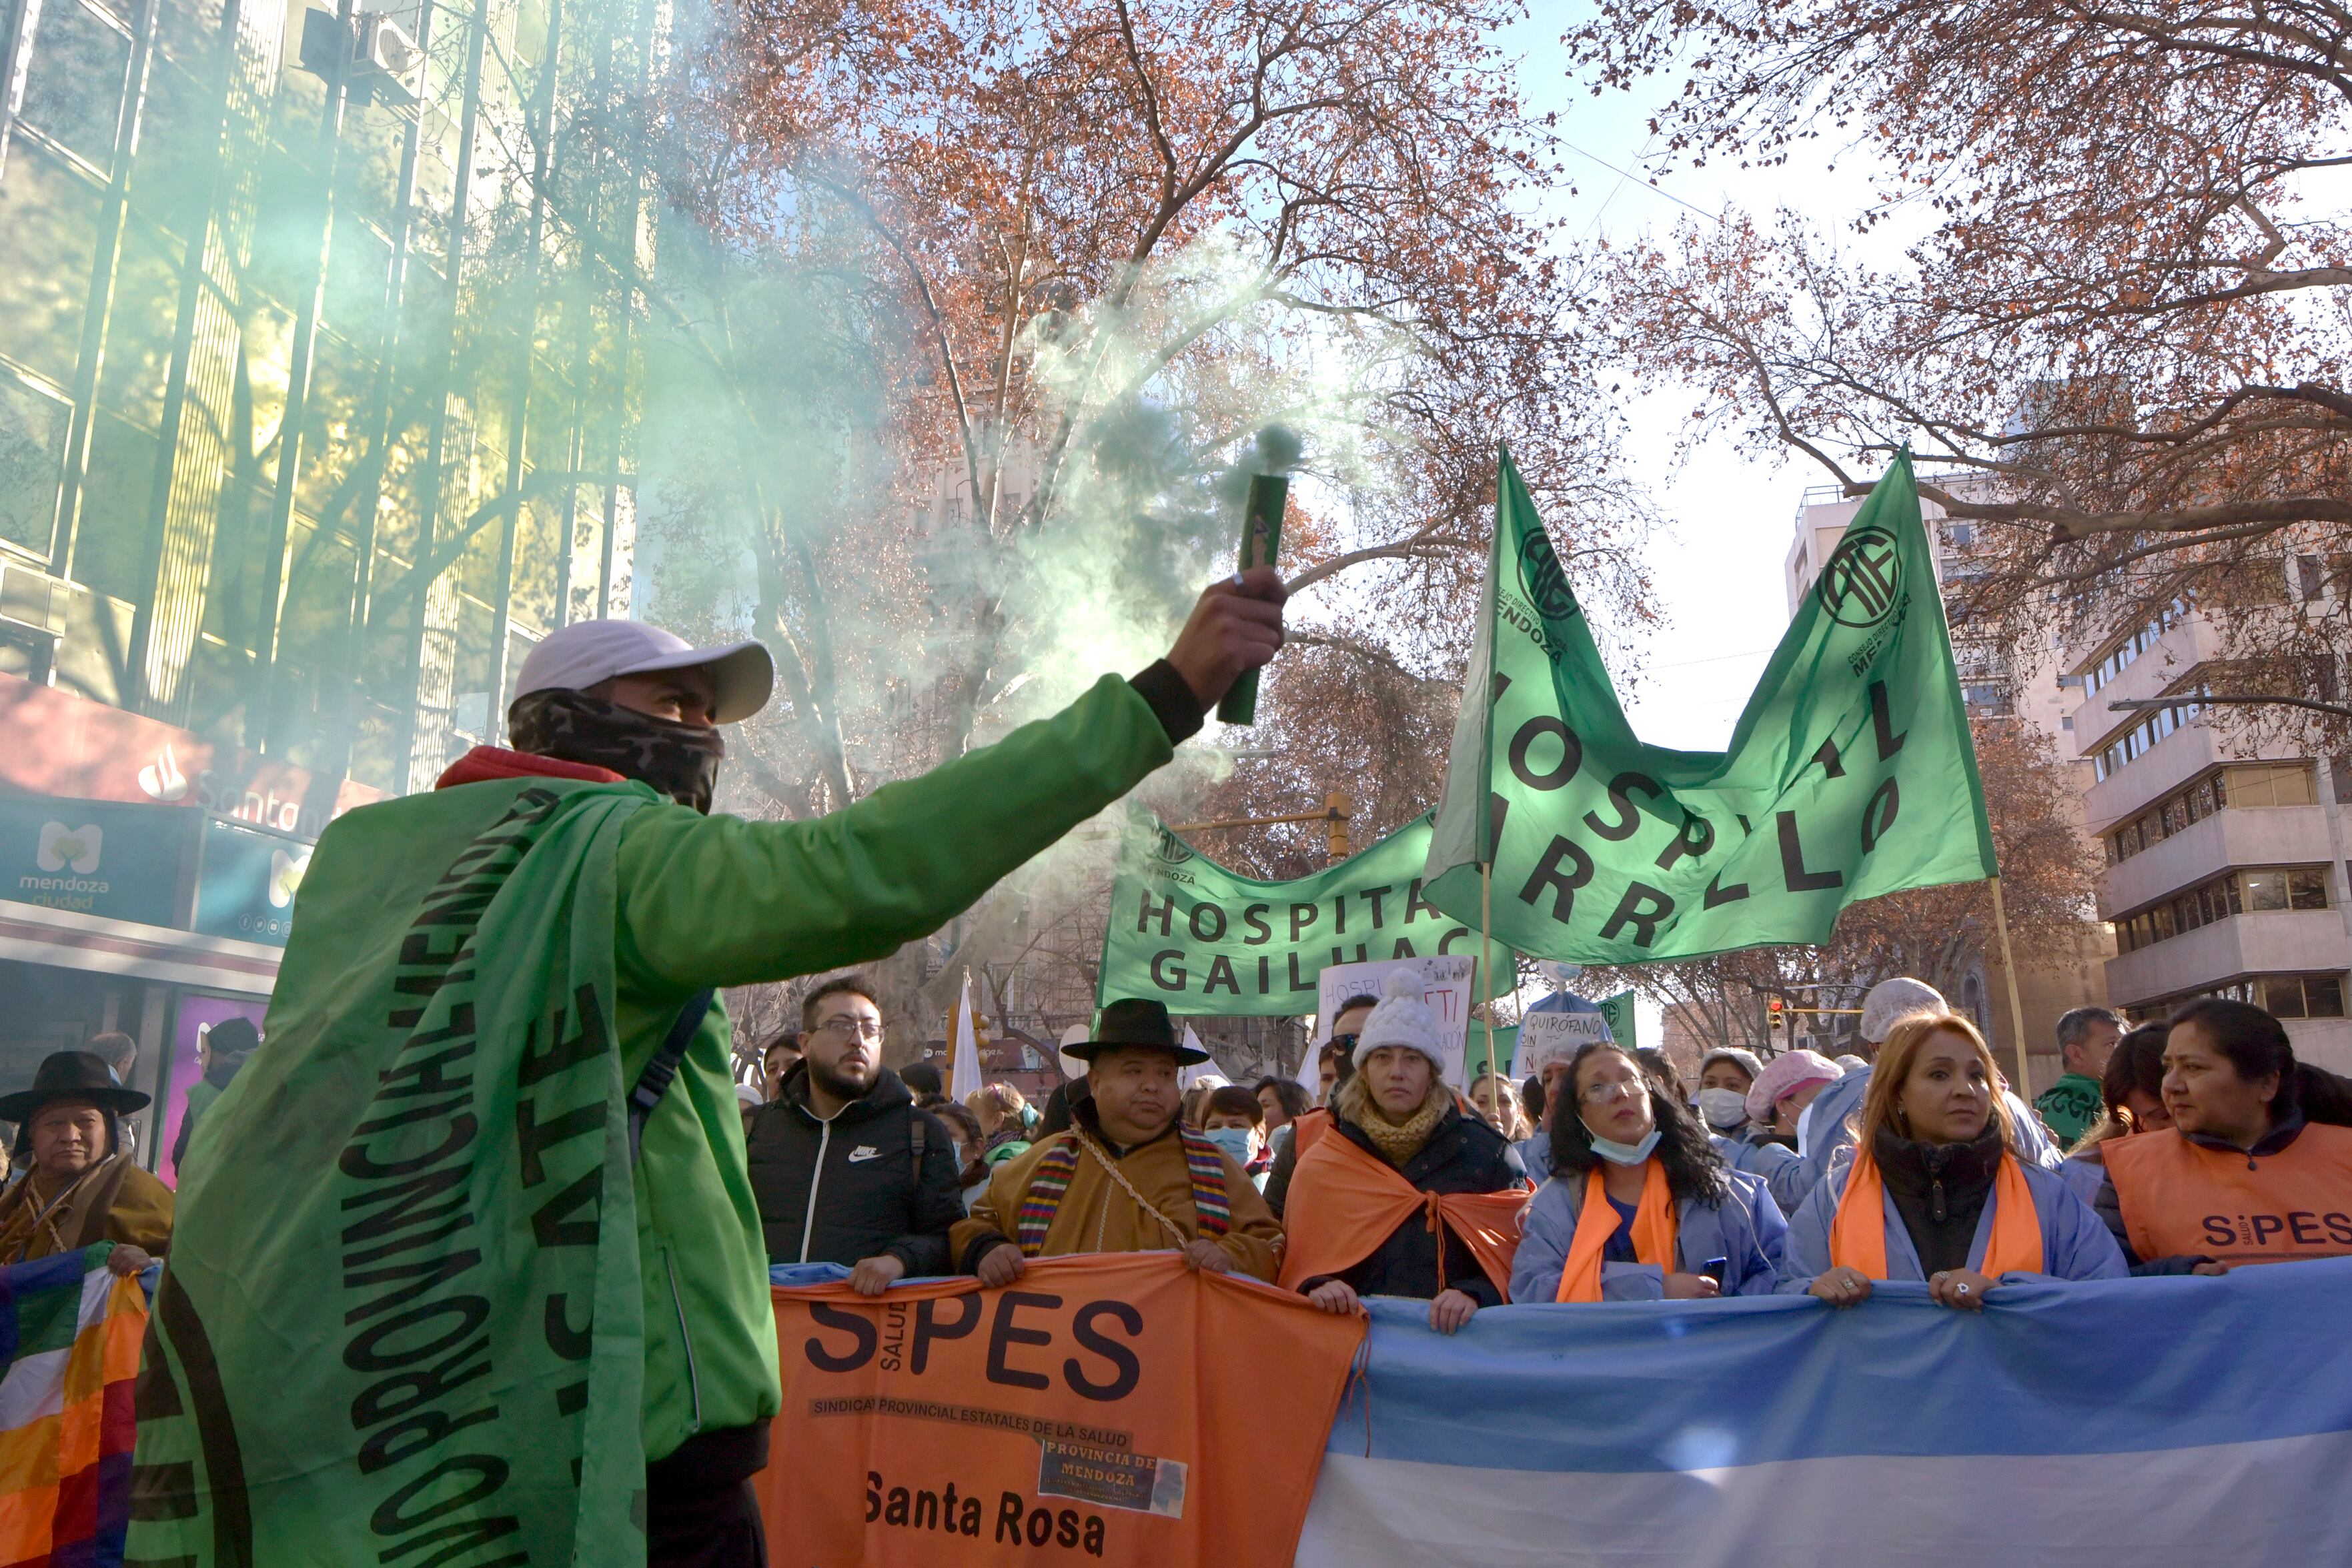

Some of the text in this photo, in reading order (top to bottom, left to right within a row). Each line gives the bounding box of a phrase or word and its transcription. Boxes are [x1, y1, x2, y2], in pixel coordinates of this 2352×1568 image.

[1826, 534, 1896, 618] ATE
[1512, 598, 1540, 625] DIRECTIVO
[1498, 600, 1562, 666] ENDOZA
[1848, 638, 1873, 664] CONSEJO
[20, 874, 109, 894] mendoza
[32, 893, 93, 910] ciudad
[1137, 878, 1442, 946] HOSPITA
[1325, 977, 1383, 1008] HOSPI
[1530, 1014, 1601, 1034] QUIRÓFANO
[854, 1145, 877, 1155] NIKE
[2239, 1222, 2253, 1245] SALUD
[880, 1302, 907, 1371] SALUD
[814, 1399, 1127, 1447] SINDICA PROVINCIAL ESTATALES DE LA SALUD
[1047, 1442, 1155, 1470] PROVINCIA DE
[1061, 1463, 1135, 1487] MENDOZA
[866, 1471, 1105, 1558] Santa Rosa
